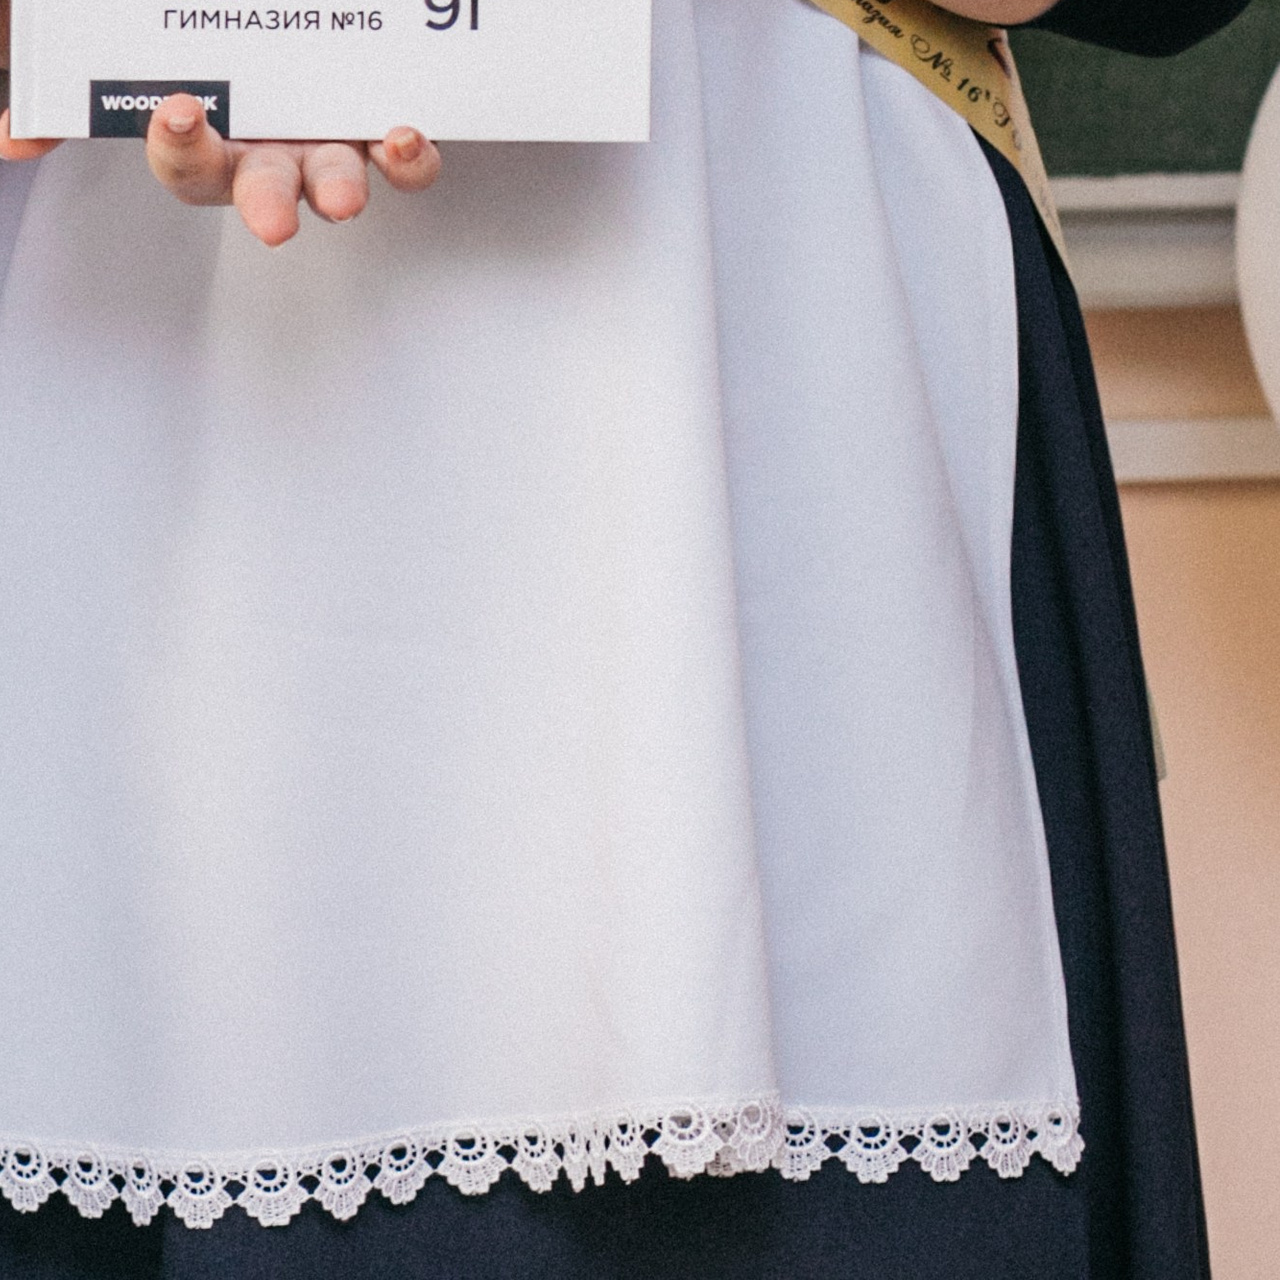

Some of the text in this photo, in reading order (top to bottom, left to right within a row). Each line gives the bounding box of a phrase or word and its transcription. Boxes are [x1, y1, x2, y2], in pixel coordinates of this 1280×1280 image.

[164, 10, 384, 32] ГИМНАЗИЯ №16
[100, 95, 219, 111] WOODK
